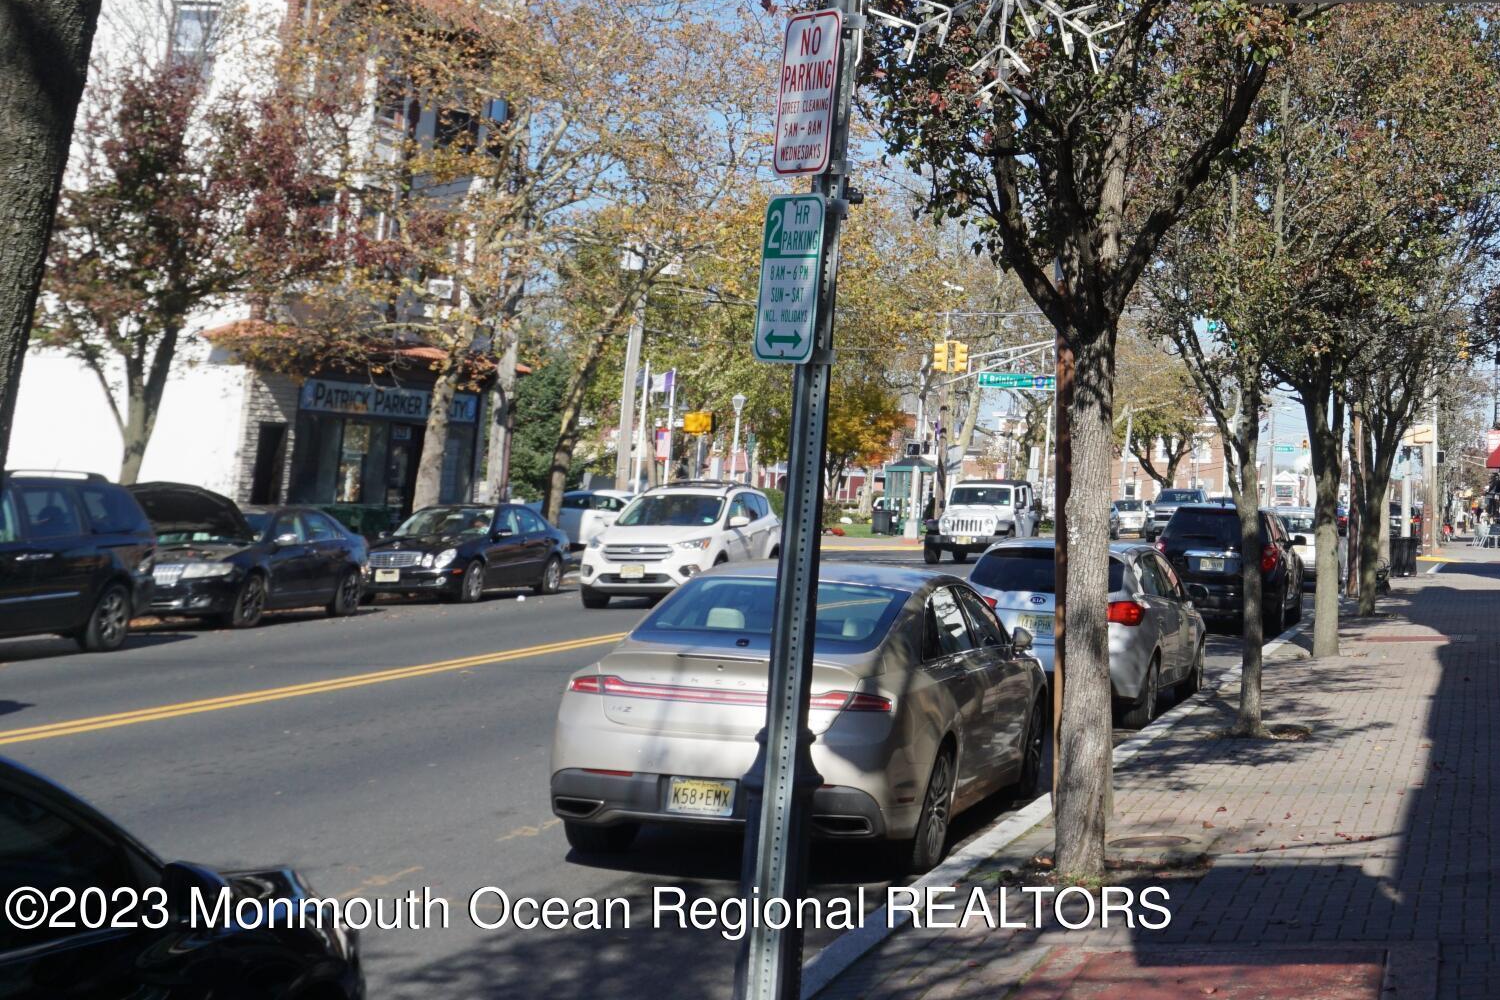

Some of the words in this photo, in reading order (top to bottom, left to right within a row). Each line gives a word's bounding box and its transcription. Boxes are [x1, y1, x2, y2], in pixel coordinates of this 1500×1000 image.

[800, 25, 822, 57] NO
[783, 60, 832, 94] PARKING
[781, 100, 800, 115] STREET
[802, 97, 829, 113] CLEANING
[780, 143, 822, 161] WEDNESDAYS
[768, 209, 782, 249] 2
[794, 204, 810, 225] HR
[781, 229, 818, 250] PARKING
[770, 287, 784, 303] SUN
[791, 287, 804, 303] SAT
[780, 309, 808, 323] HOLIDAYS
[313, 383, 371, 412] PATRICK
[374, 391, 422, 415] PARKER
